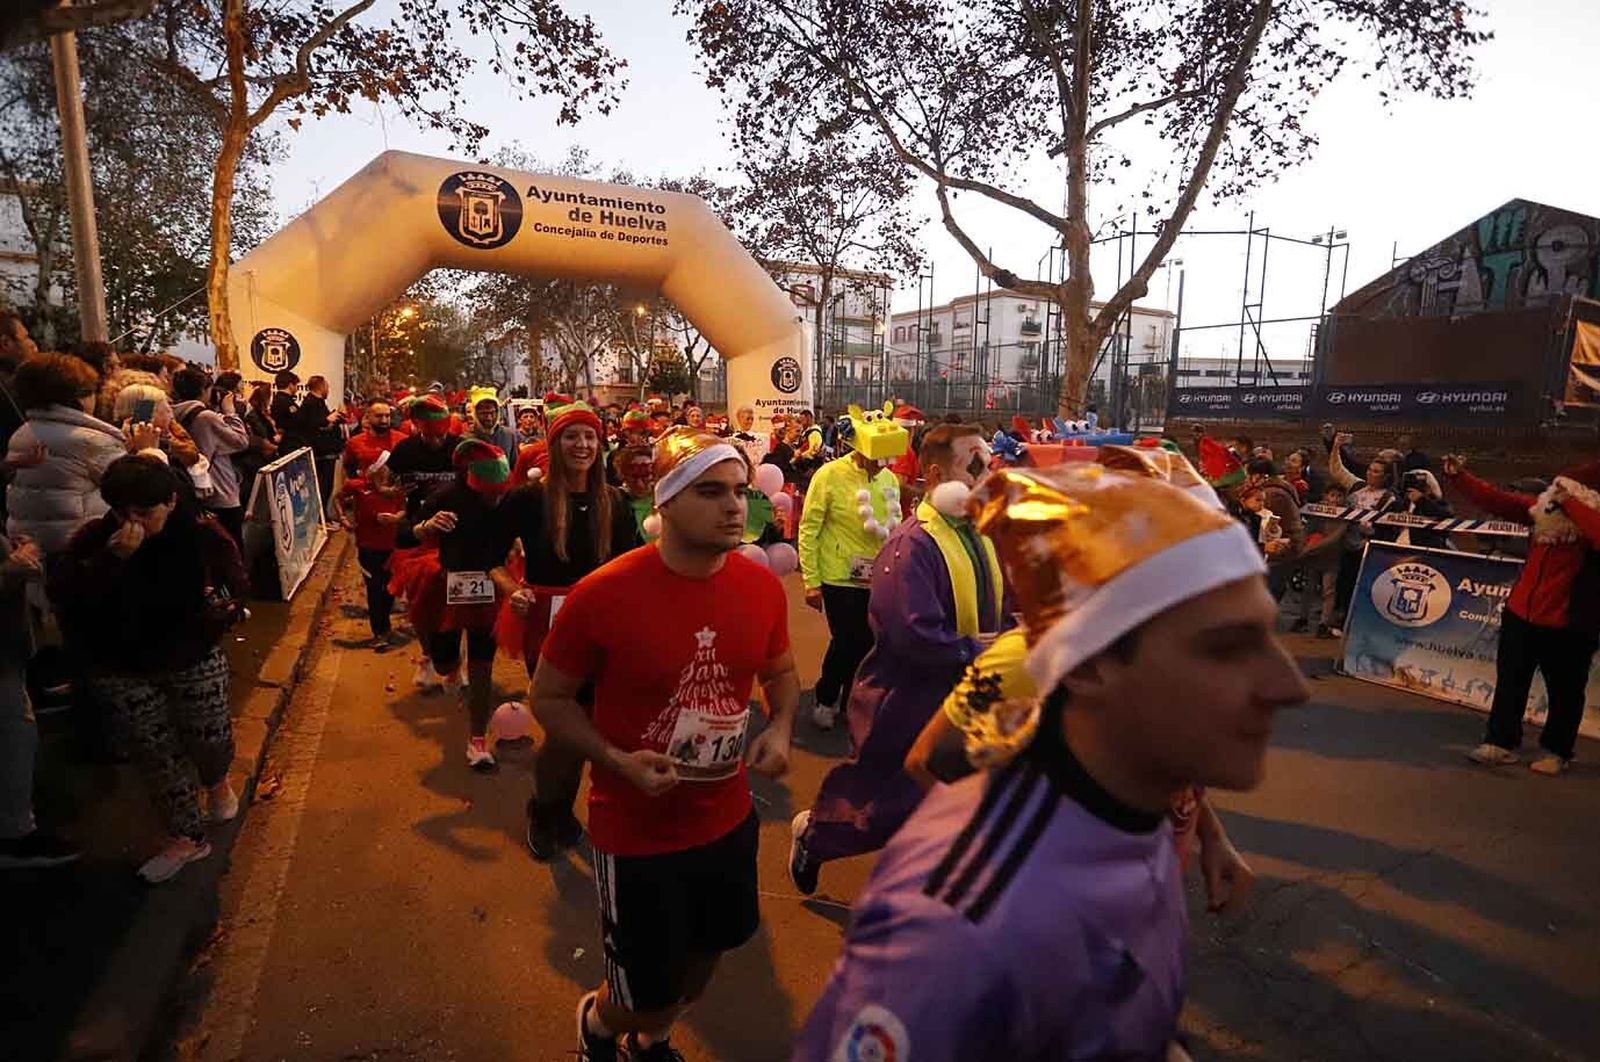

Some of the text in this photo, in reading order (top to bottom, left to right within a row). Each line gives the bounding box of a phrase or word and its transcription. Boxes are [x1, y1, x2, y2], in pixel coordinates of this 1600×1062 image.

[526, 185, 667, 215] Ayuntamiento
[568, 207, 667, 232] de Huelva
[599, 229, 615, 241] de
[617, 231, 669, 247] Deportes
[1192, 394, 1233, 403] HYUNDAI
[1258, 394, 1303, 403] HYUNDAI
[1347, 393, 1402, 403] HYUNDAI
[1441, 392, 1508, 403] HYUNDAI
[469, 580, 485, 594] 21
[1456, 576, 1512, 598] Ayun
[1458, 610, 1503, 627] Concej
